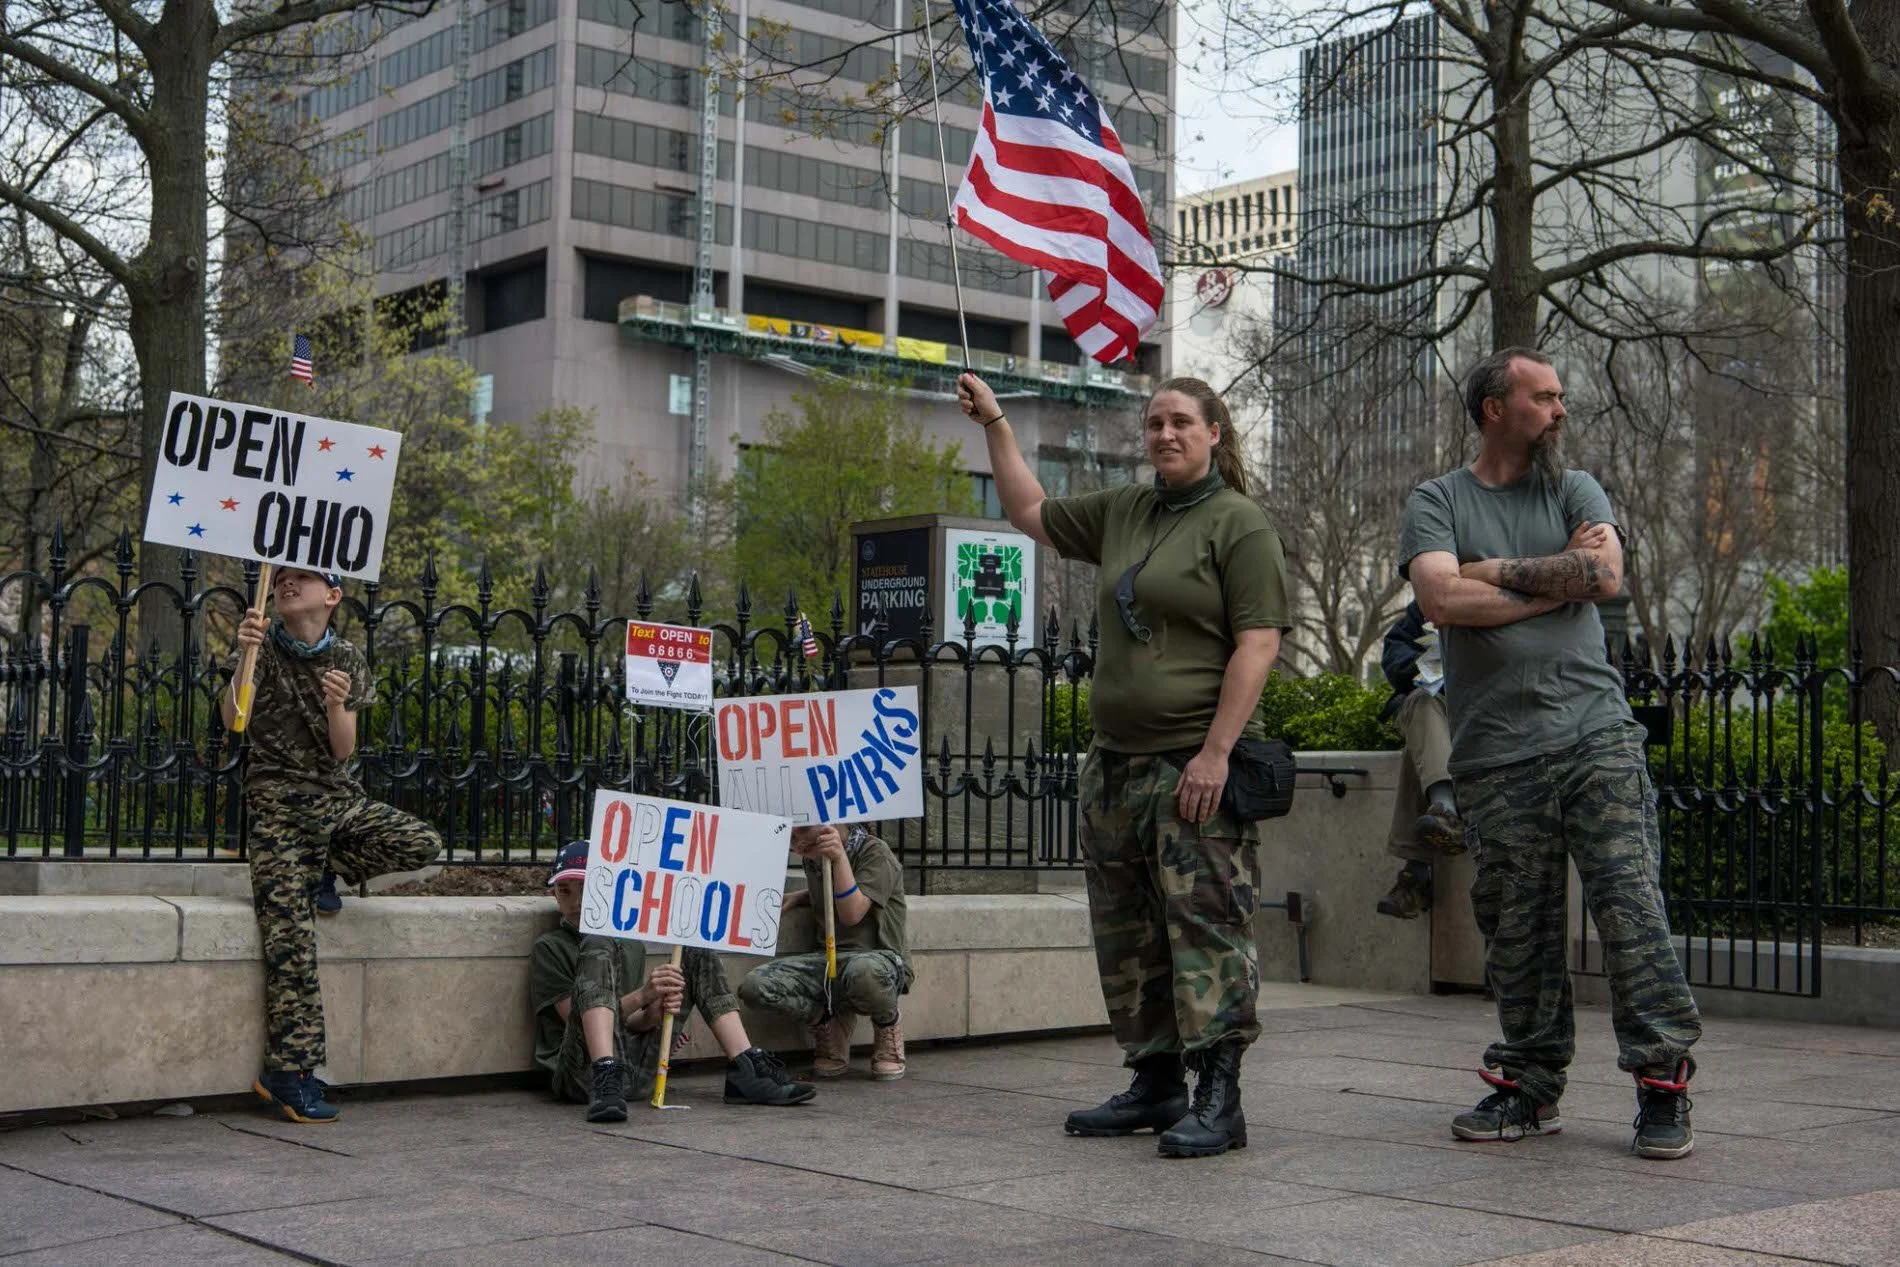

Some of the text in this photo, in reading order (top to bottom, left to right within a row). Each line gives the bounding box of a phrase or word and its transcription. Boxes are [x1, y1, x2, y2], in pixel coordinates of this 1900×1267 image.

[164, 400, 306, 487] OPEN
[253, 491, 373, 572] OHIO
[861, 565, 907, 577] STATEHOUSE
[861, 576, 925, 590] UNDERGROUND
[632, 626, 709, 644] Text OPEN to
[631, 686, 639, 694] To
[655, 689, 666, 697] the
[666, 690, 683, 699] Fight
[718, 698, 838, 761] OPEN
[806, 688, 919, 823] PARKS
[600, 800, 720, 875] OPEN
[583, 866, 783, 950] SCHOOLS
